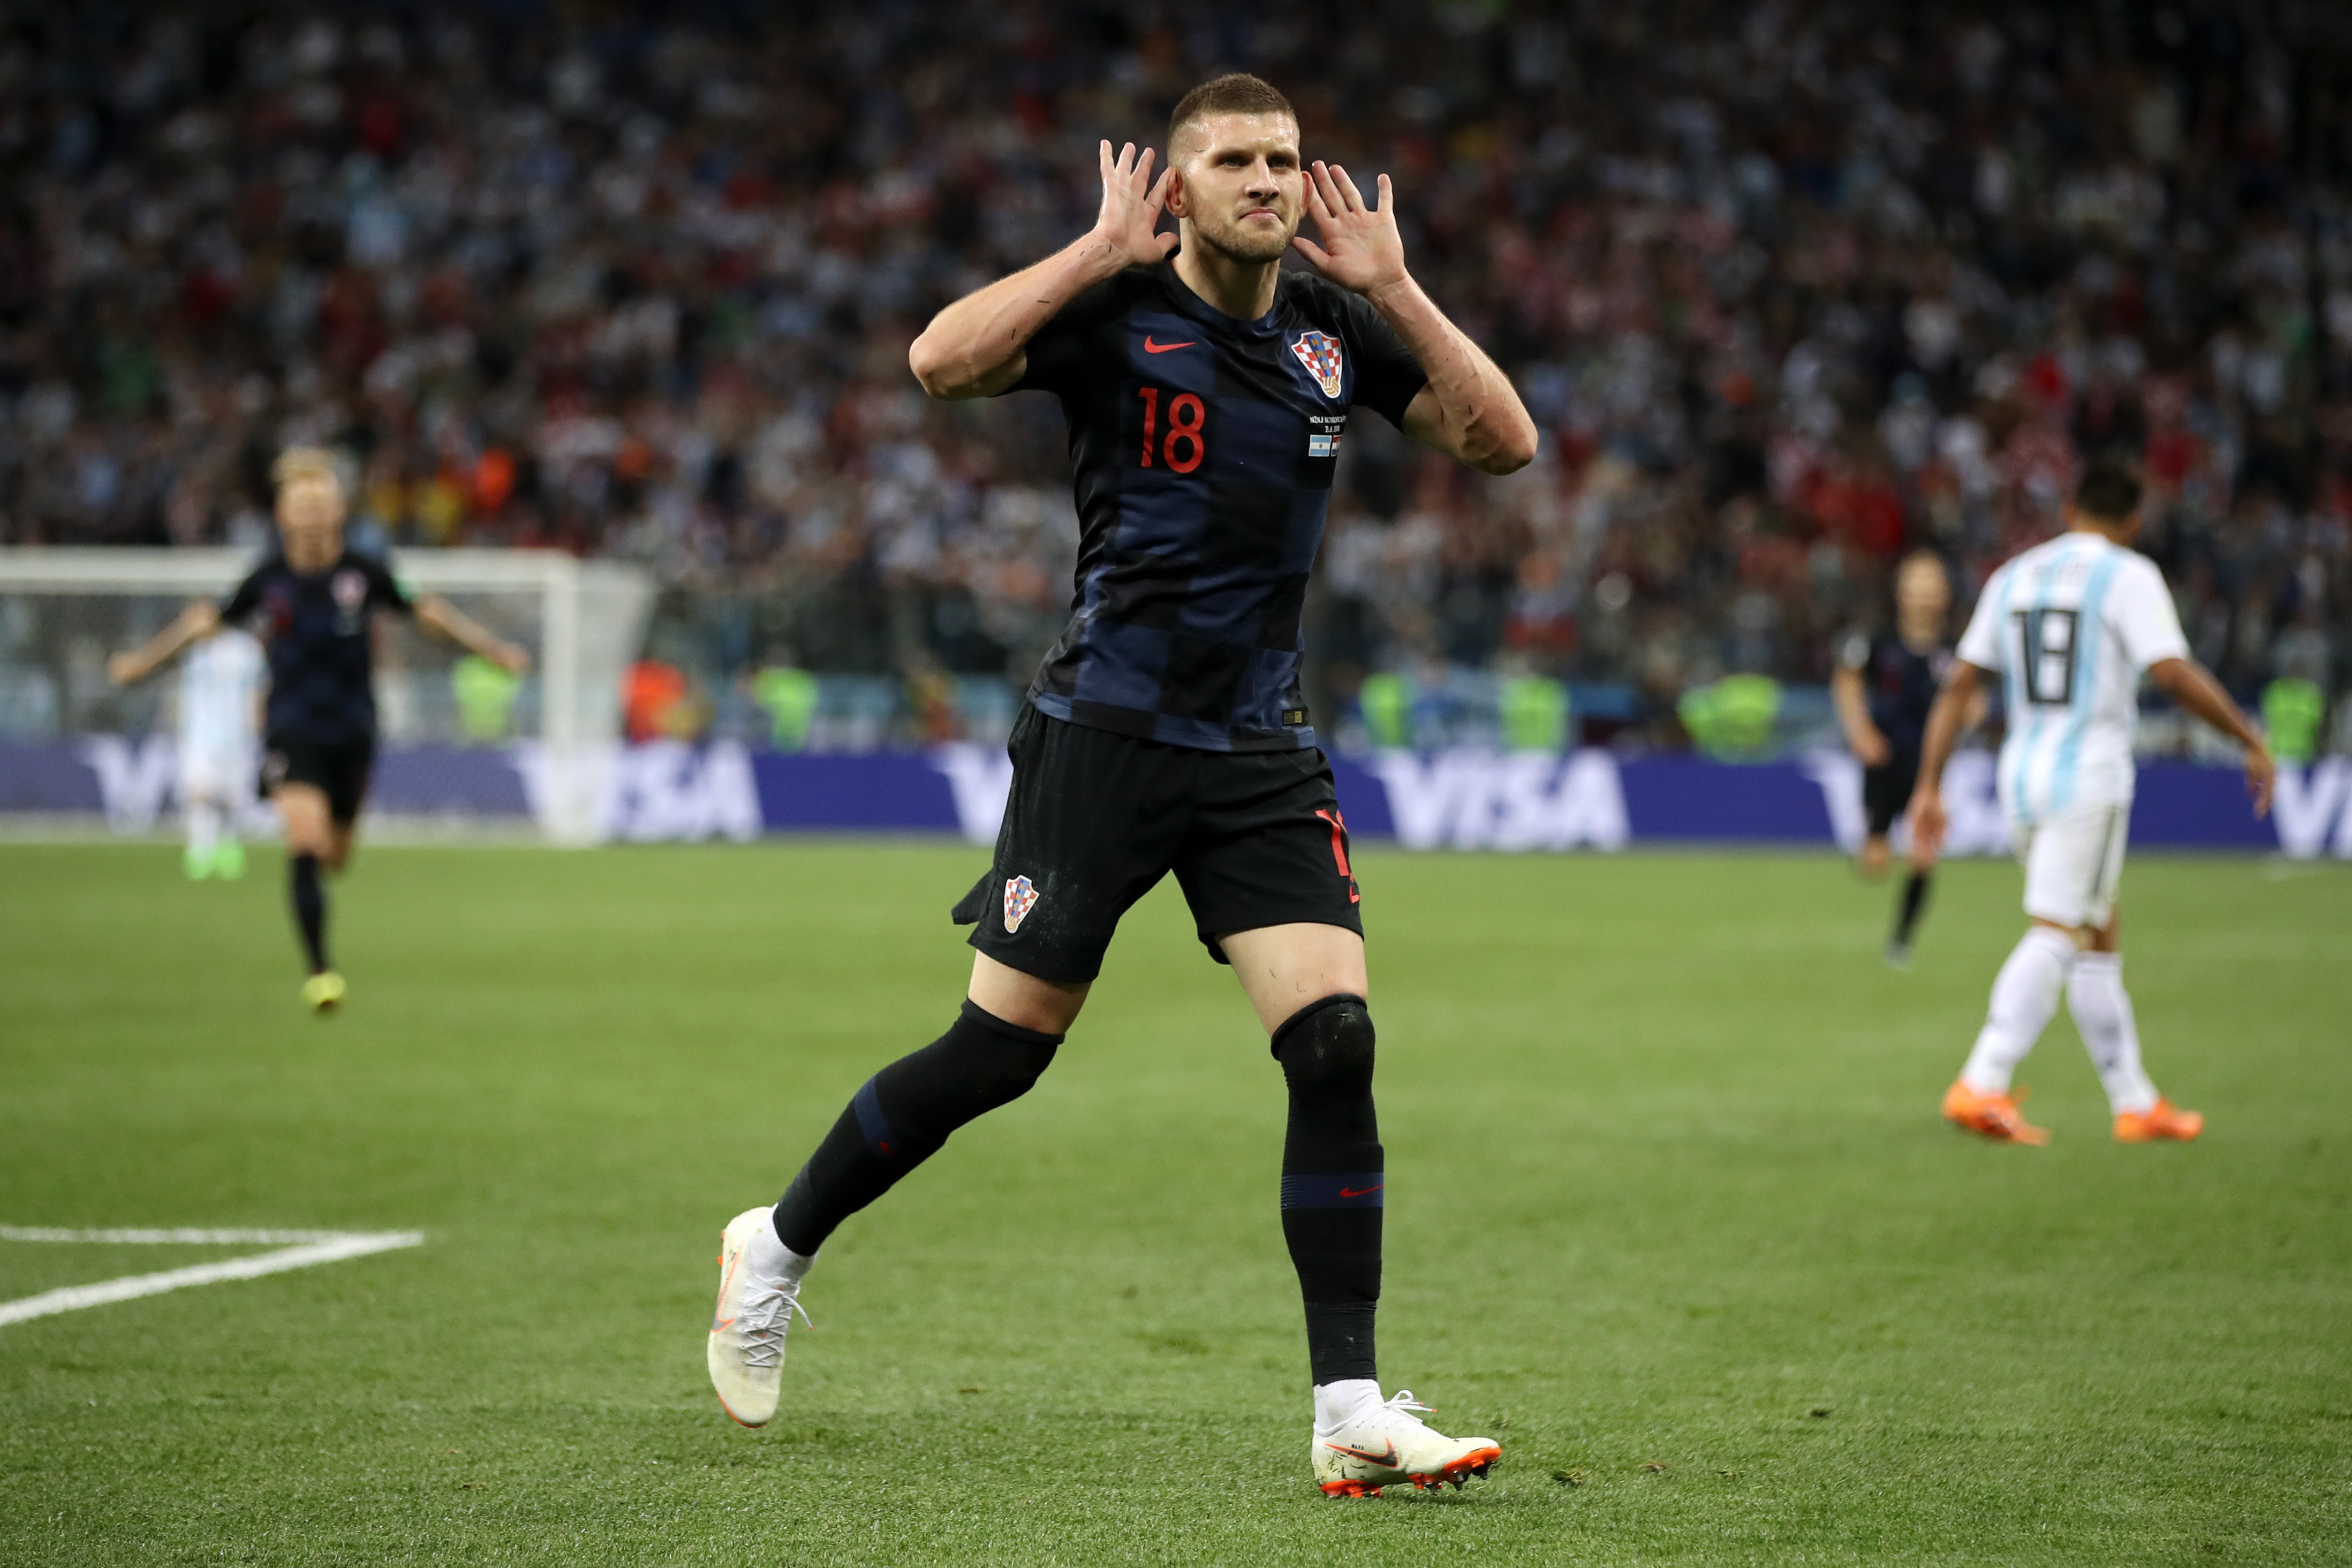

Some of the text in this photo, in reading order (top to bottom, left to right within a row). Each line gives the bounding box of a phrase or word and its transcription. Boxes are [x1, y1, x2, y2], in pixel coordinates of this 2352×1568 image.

[1138, 387, 1205, 473] 18
[1364, 747, 1631, 851] VISA
[1315, 808, 1360, 904] 1
